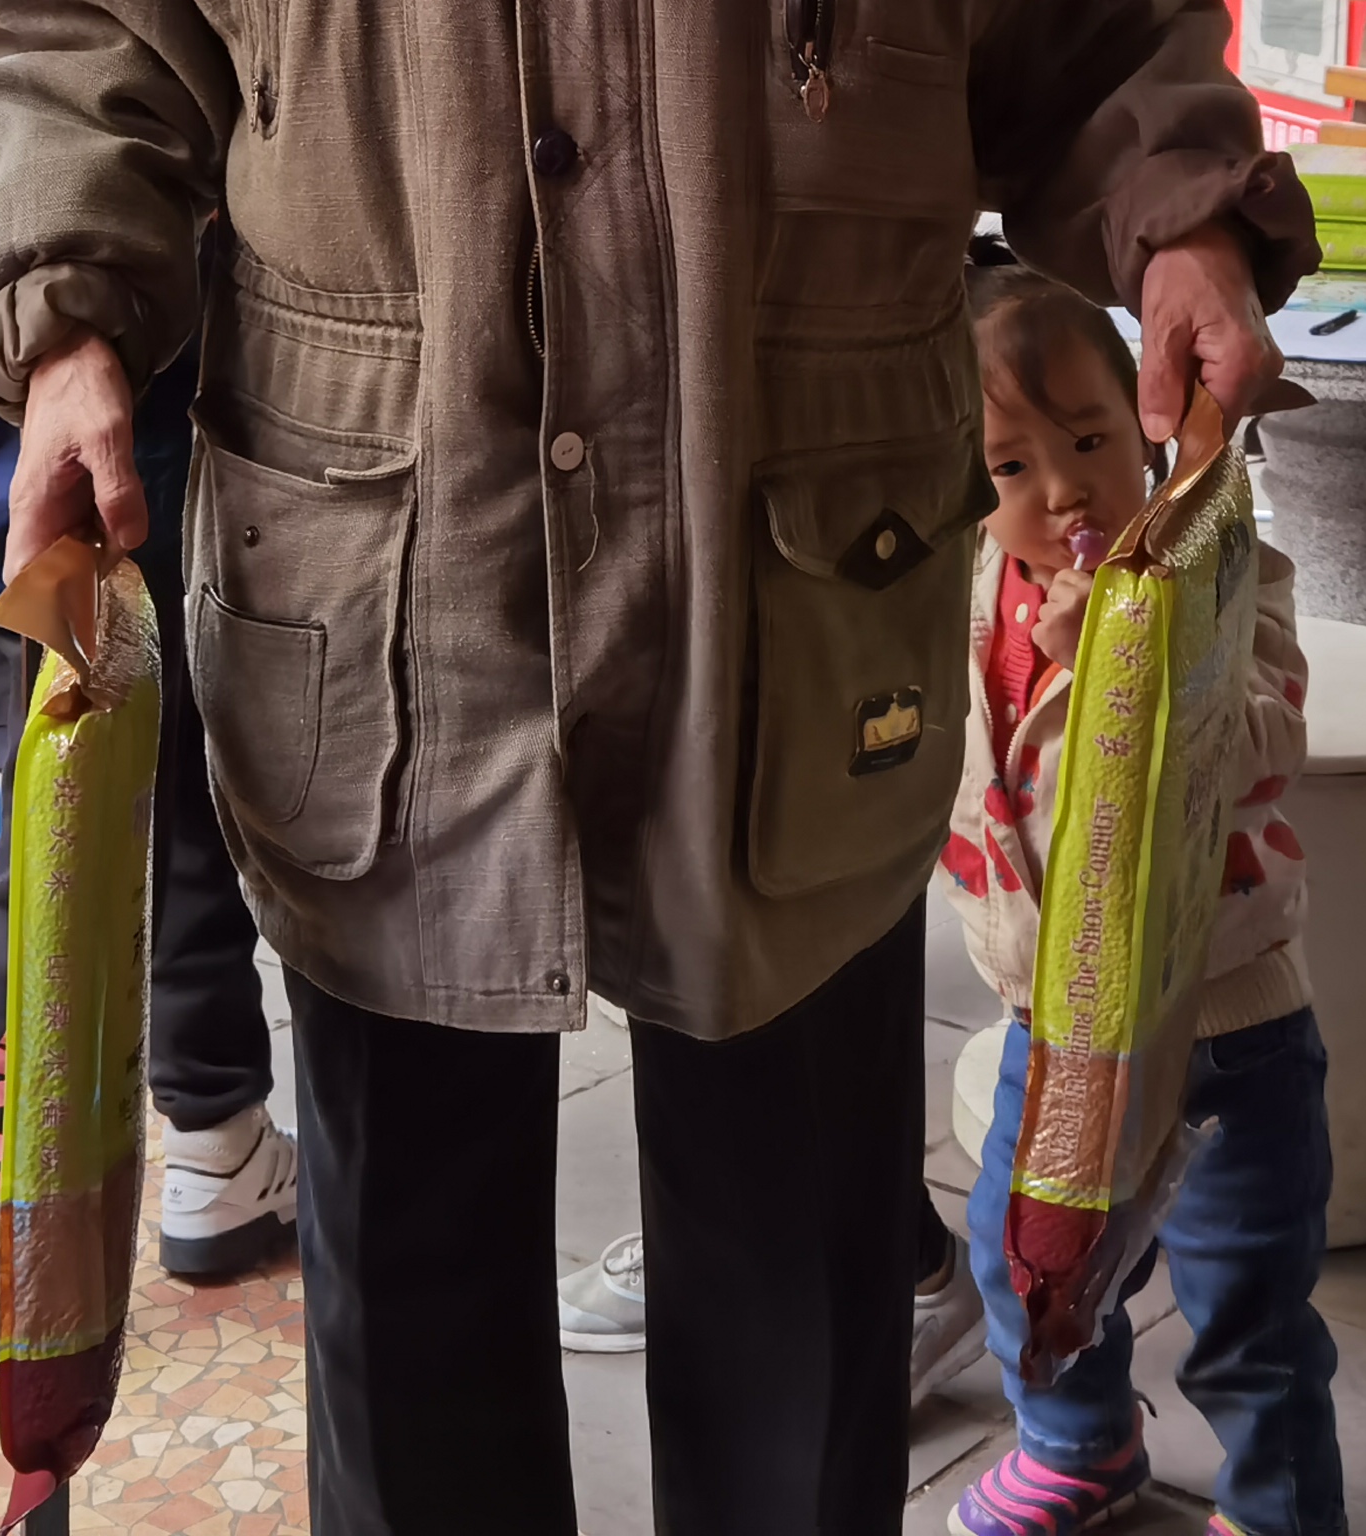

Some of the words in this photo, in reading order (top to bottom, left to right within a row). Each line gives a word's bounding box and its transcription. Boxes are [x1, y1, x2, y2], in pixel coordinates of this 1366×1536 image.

[1078, 796, 1122, 891] Country
[1071, 896, 1103, 955] Snow
[1066, 960, 1099, 1005] The
[1058, 1011, 1094, 1074] China
